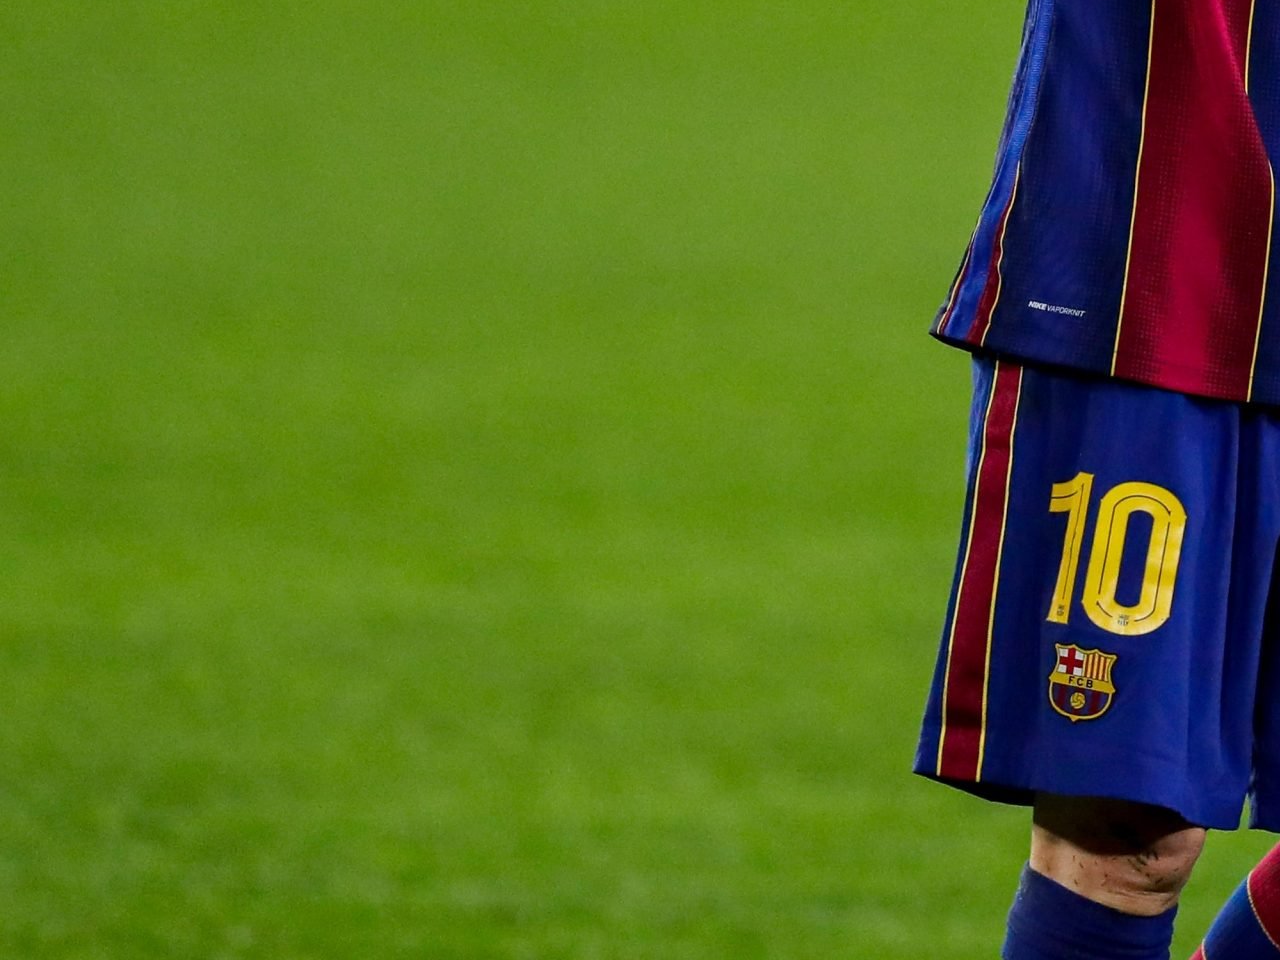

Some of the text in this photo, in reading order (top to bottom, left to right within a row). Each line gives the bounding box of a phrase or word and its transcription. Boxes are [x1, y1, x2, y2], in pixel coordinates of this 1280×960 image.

[1028, 300, 1086, 317] NIKE VAPORKNIT
[1046, 471, 1187, 636] 10
[1068, 675, 1093, 689] FCB
